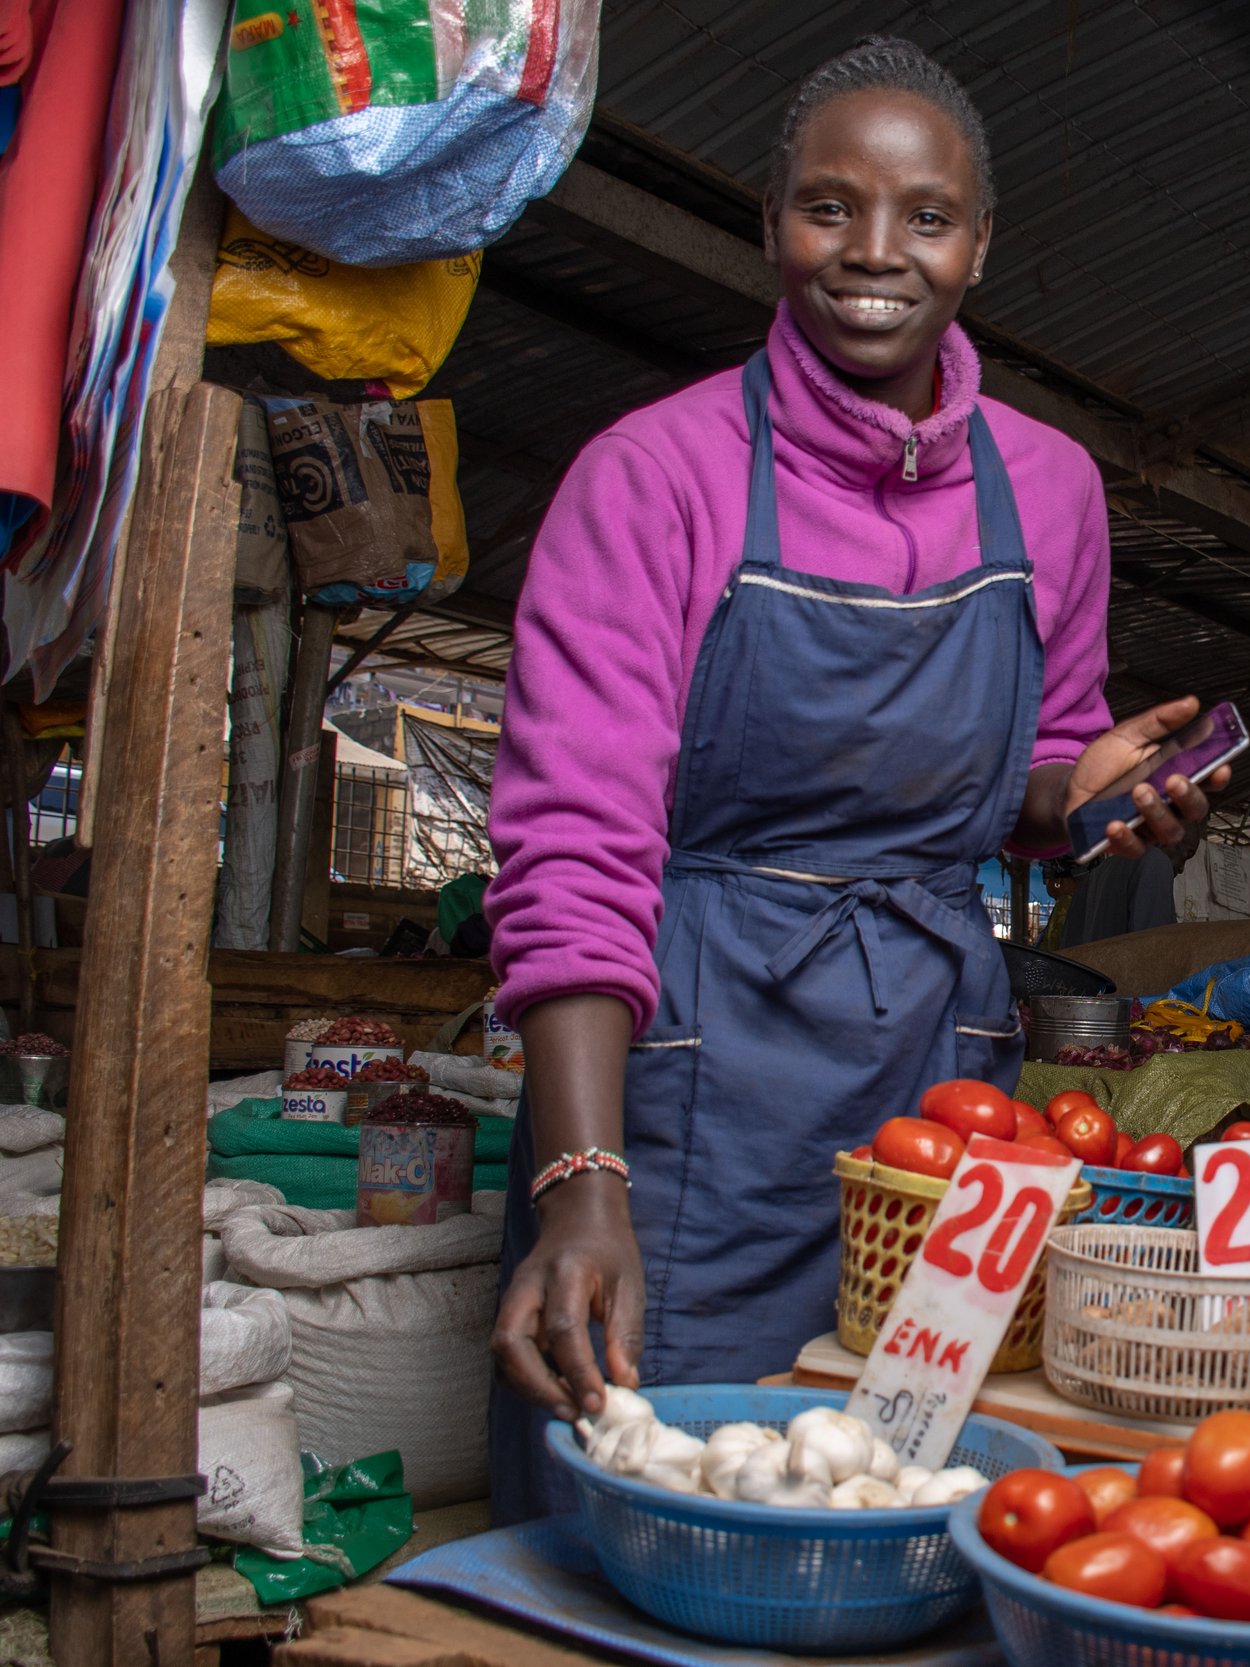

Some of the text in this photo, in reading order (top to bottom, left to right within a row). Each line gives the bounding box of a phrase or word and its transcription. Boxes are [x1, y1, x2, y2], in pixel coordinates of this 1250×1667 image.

[283, 1095, 326, 1114] zesta
[922, 1163, 1055, 1294] 20
[884, 1318, 972, 1374] ENK
